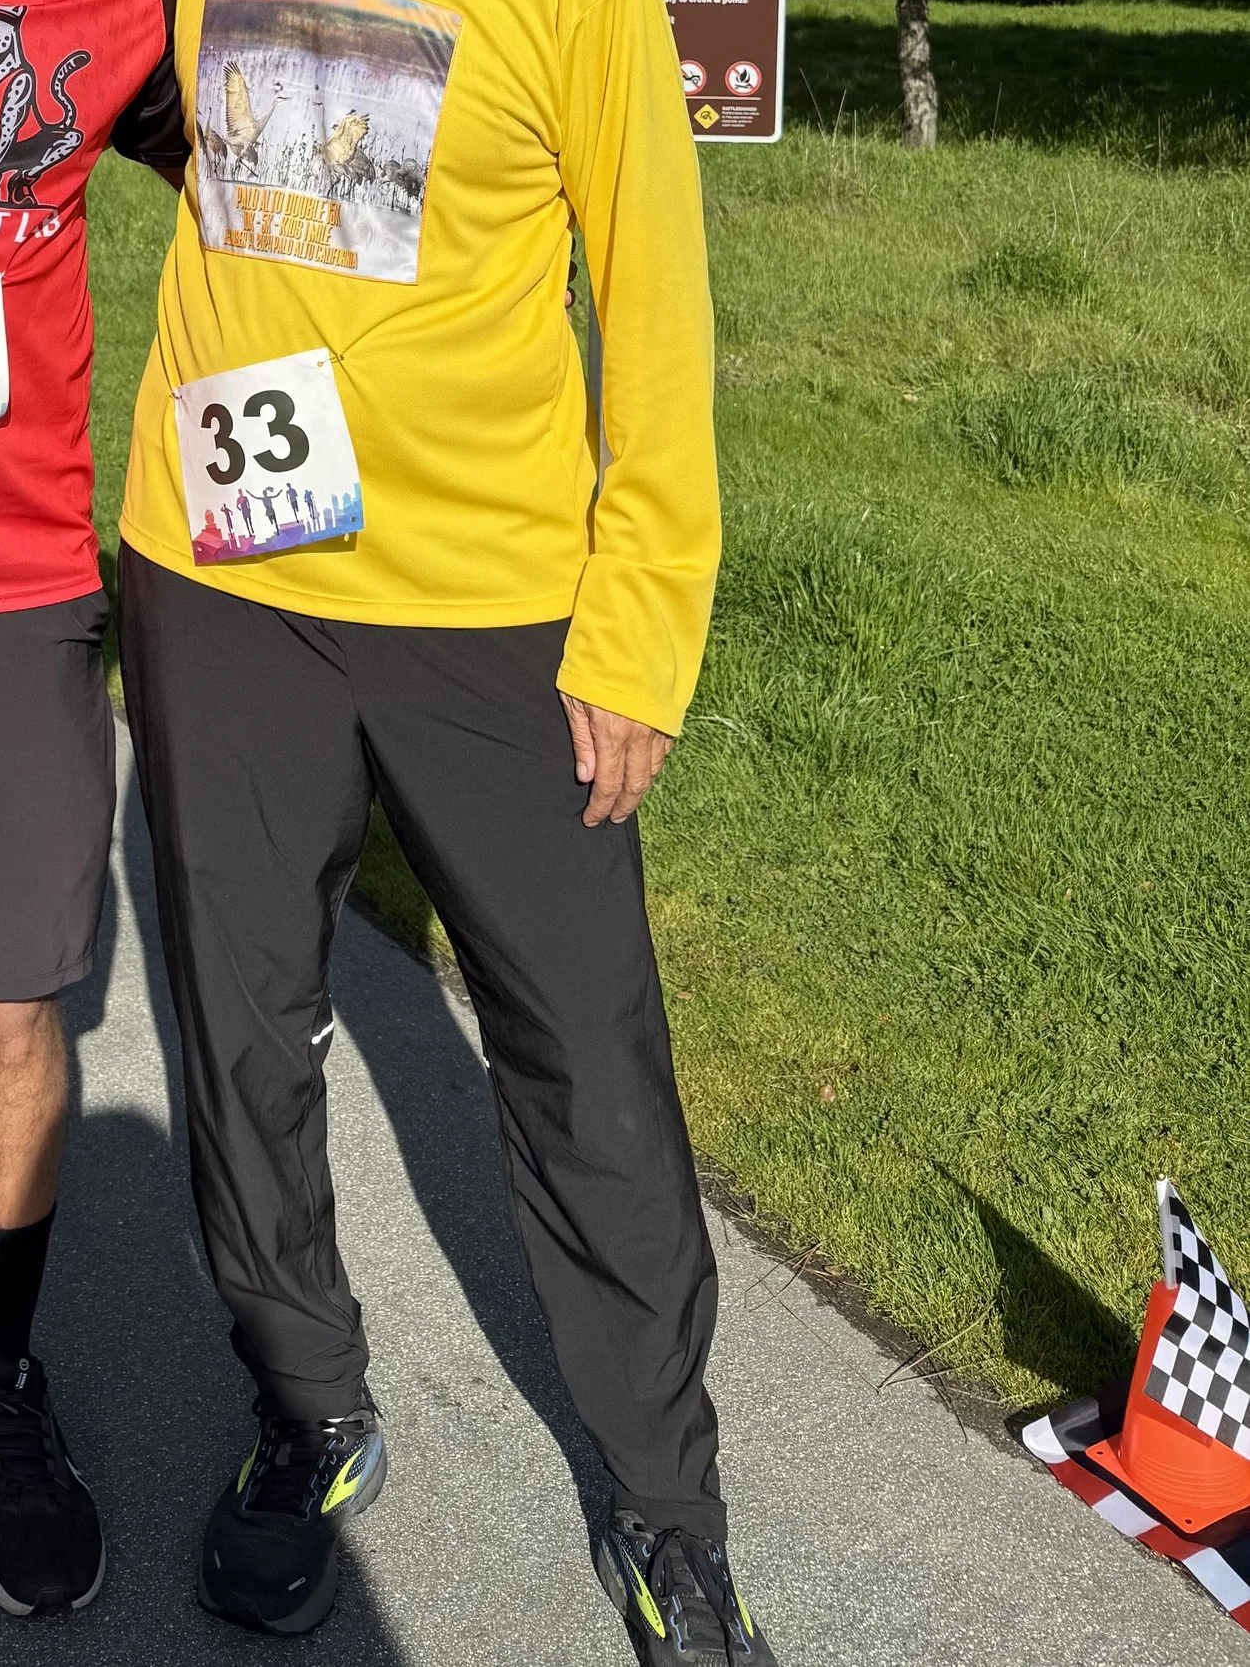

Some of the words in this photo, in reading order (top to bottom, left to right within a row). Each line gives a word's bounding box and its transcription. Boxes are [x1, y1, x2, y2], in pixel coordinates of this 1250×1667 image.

[235, 186, 259, 211] PALO
[258, 189, 285, 214] ALTO
[284, 193, 328, 223] DOUBLE
[307, 223, 332, 246] MILE
[200, 389, 310, 485] 33
